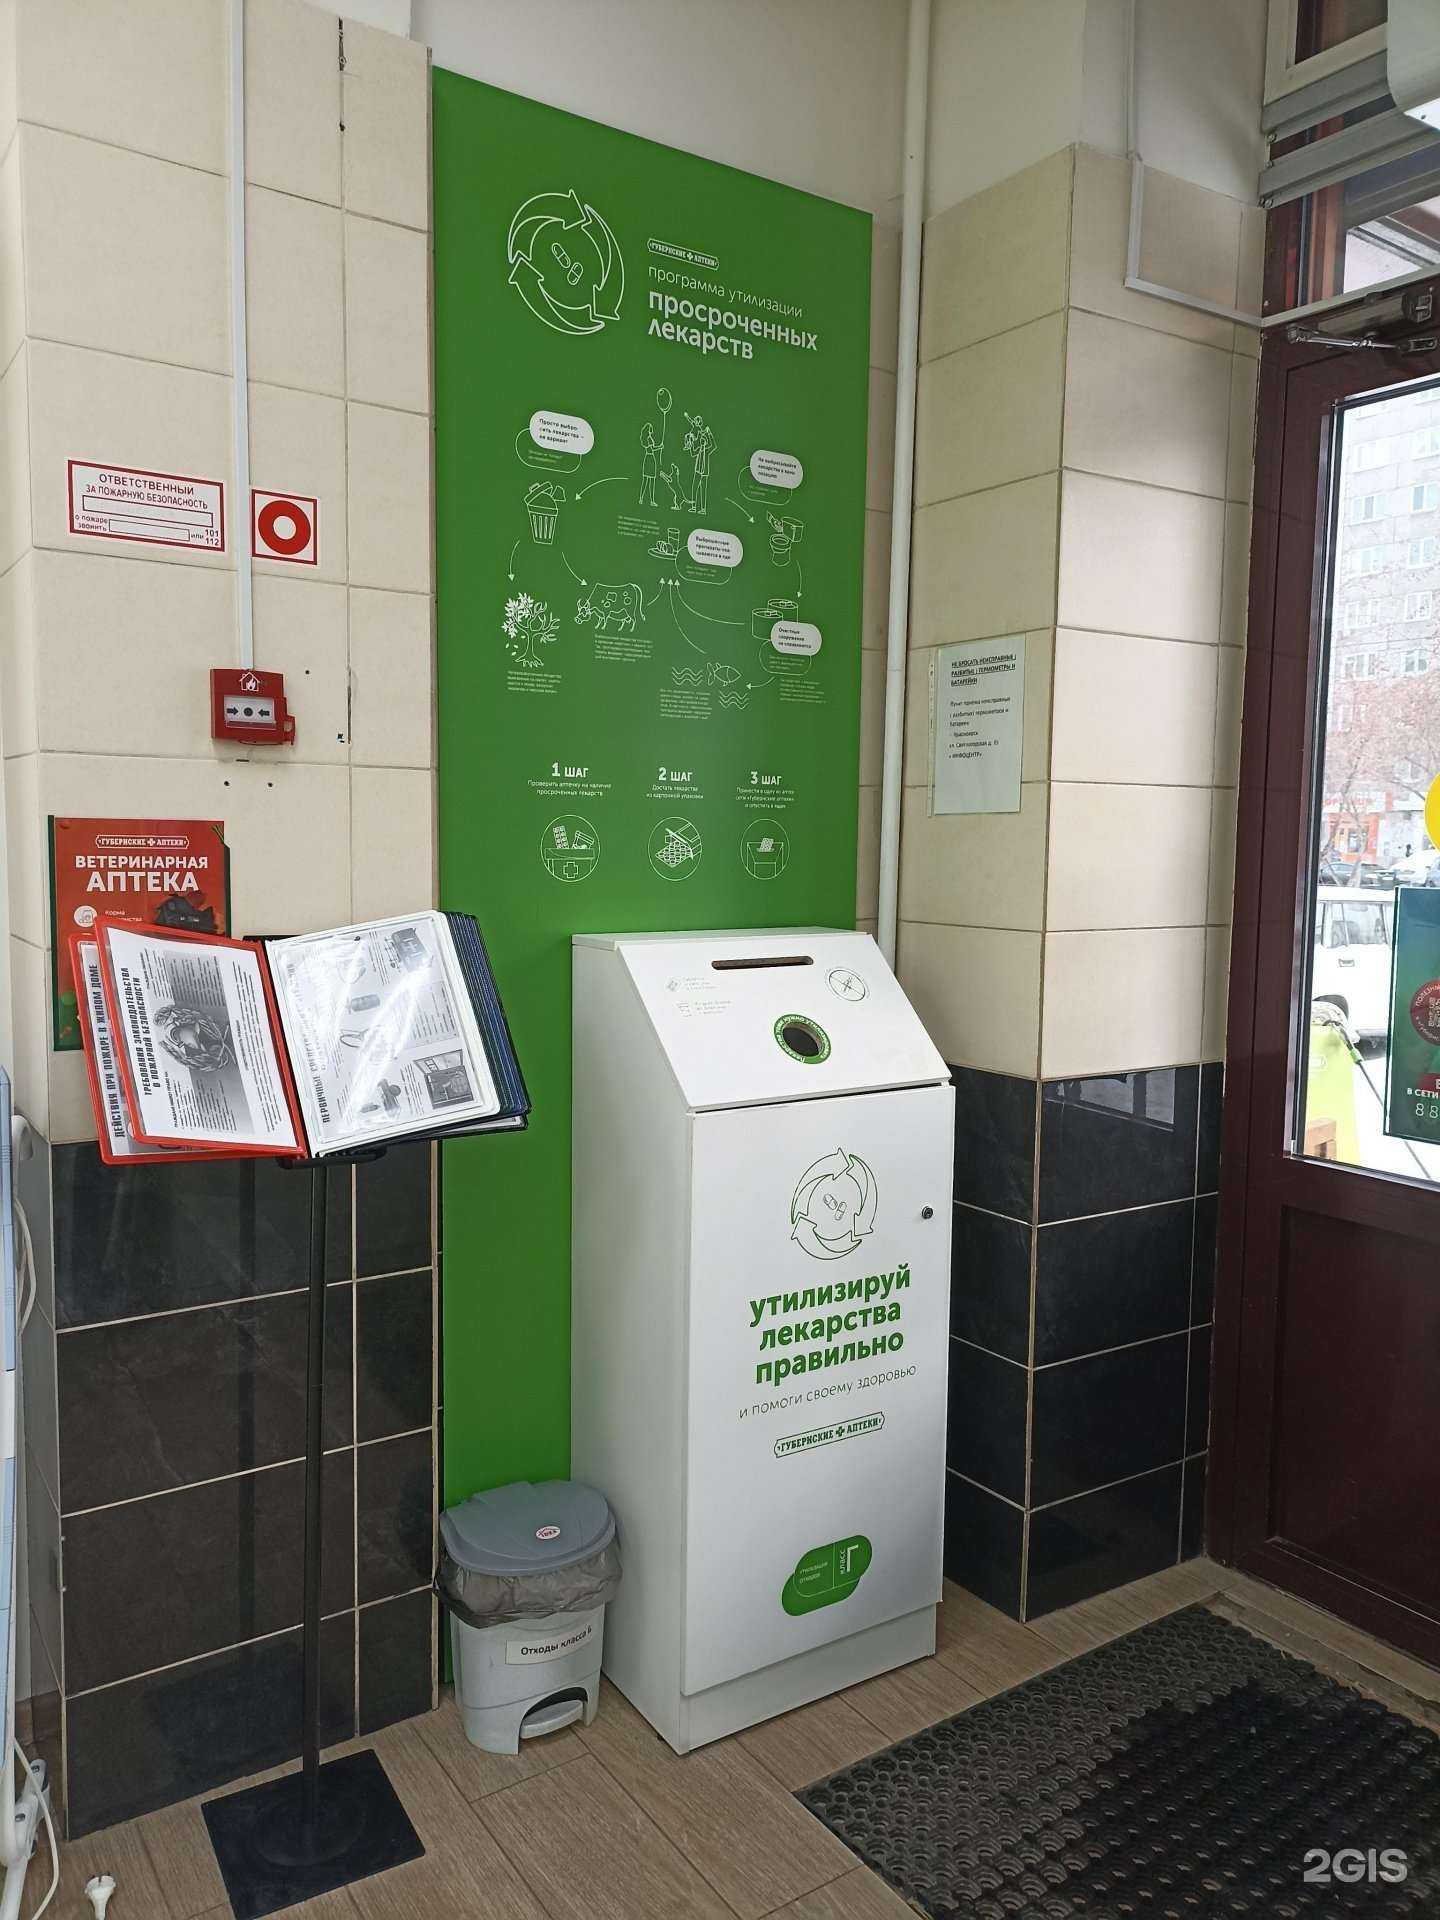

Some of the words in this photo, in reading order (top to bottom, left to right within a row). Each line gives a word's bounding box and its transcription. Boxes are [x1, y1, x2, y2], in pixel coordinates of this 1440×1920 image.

[652, 242, 686, 258] ГУБЕРНСКИЕ
[694, 255, 715, 266] АПТЕКИ
[649, 266, 725, 297] программа
[729, 289, 802, 318] утилизации
[649, 291, 818, 351] просроченных
[648, 318, 753, 359] лекарств
[540, 418, 559, 427] Просто
[553, 429, 579, 438] лекарства
[99, 473, 194, 495] ОТВЕТСТВЕННЫЙ
[86, 484, 96, 494] ЗА
[99, 486, 145, 501] ПОЖАРНУЮ
[147, 493, 208, 509] БЕЗОПАСНОСТЬ
[78, 522, 107, 532] звонить
[81, 515, 108, 524] пожаре
[205, 529, 219, 537] 101
[959, 659, 978, 667] БРОСАТЬ
[979, 665, 1010, 673] ТЕРМОМЕТРЫ
[552, 762, 560, 776] 1
[564, 767, 588, 777] ШАГ
[659, 767, 666, 780] 2
[671, 771, 692, 781] ШАГ
[751, 771, 758, 784] 3
[761, 776, 781, 785] ШАГ
[100, 838, 146, 846] ГУБЕРНСКИЕ
[156, 838, 184, 846] АПТЕКИ
[75, 855, 208, 869] ВЕТЕРИНАРНАЯ
[86, 871, 199, 892] АПТЕКА
[90, 964, 102, 988] ДОМЕ
[94, 992, 106, 1024] ЖИЛОМ
[121, 967, 142, 1043] ЗАКОНОДАТЕЛЬСТВА
[133, 977, 151, 1035] БЕЗОПАСНОСТИ
[100, 1035, 113, 1070] ПОЖАРЕ
[145, 1037, 159, 1080] ПОЖАРНОЙ
[107, 1073, 115, 1090] ПРИ
[136, 1047, 152, 1095] ТРЕБОВАНИЯ
[313, 1076, 330, 1123] ПЕРВИЧНЫЕ
[1415, 1089, 1439, 1098] СЕТИ
[109, 1093, 125, 1138] ДЕЙСТВИЯ
[1416, 1103, 1424, 1116] 8
[750, 1263, 911, 1327] утилизируй
[759, 1301, 901, 1351] лекарства
[756, 1332, 904, 1387] правильно
[739, 1408, 748, 1419] и
[752, 1394, 802, 1415] помоги
[806, 1380, 853, 1402] своему
[857, 1365, 917, 1390] здоровью
[780, 1430, 833, 1451] ГУБЕРНСКИЕ
[847, 1418, 878, 1433] АПТЕКИ
[521, 1644, 558, 1655] Отходы
[561, 1631, 586, 1647] класса
